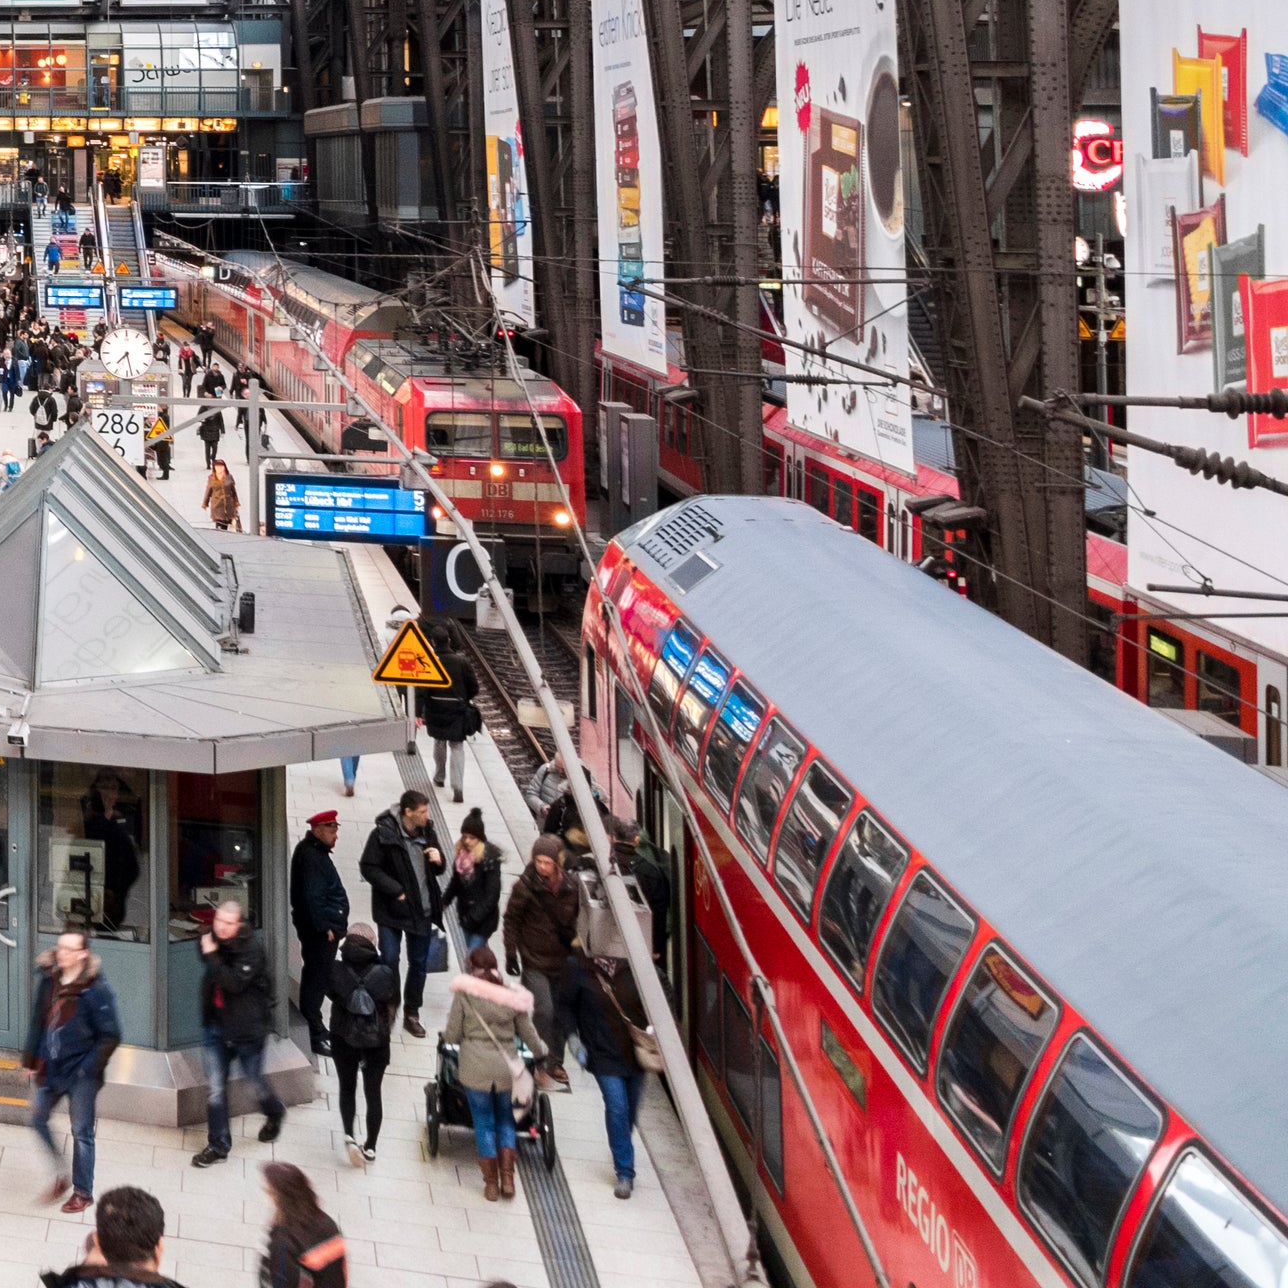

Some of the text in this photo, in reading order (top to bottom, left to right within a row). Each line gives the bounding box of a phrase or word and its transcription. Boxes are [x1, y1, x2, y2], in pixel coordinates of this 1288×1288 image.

[219, 268, 230, 280] D
[97, 413, 140, 436] 286
[113, 438, 126, 458] 6
[413, 490, 425, 506] 5
[486, 483, 508, 497] DB
[896, 1150, 951, 1273] REGIO
